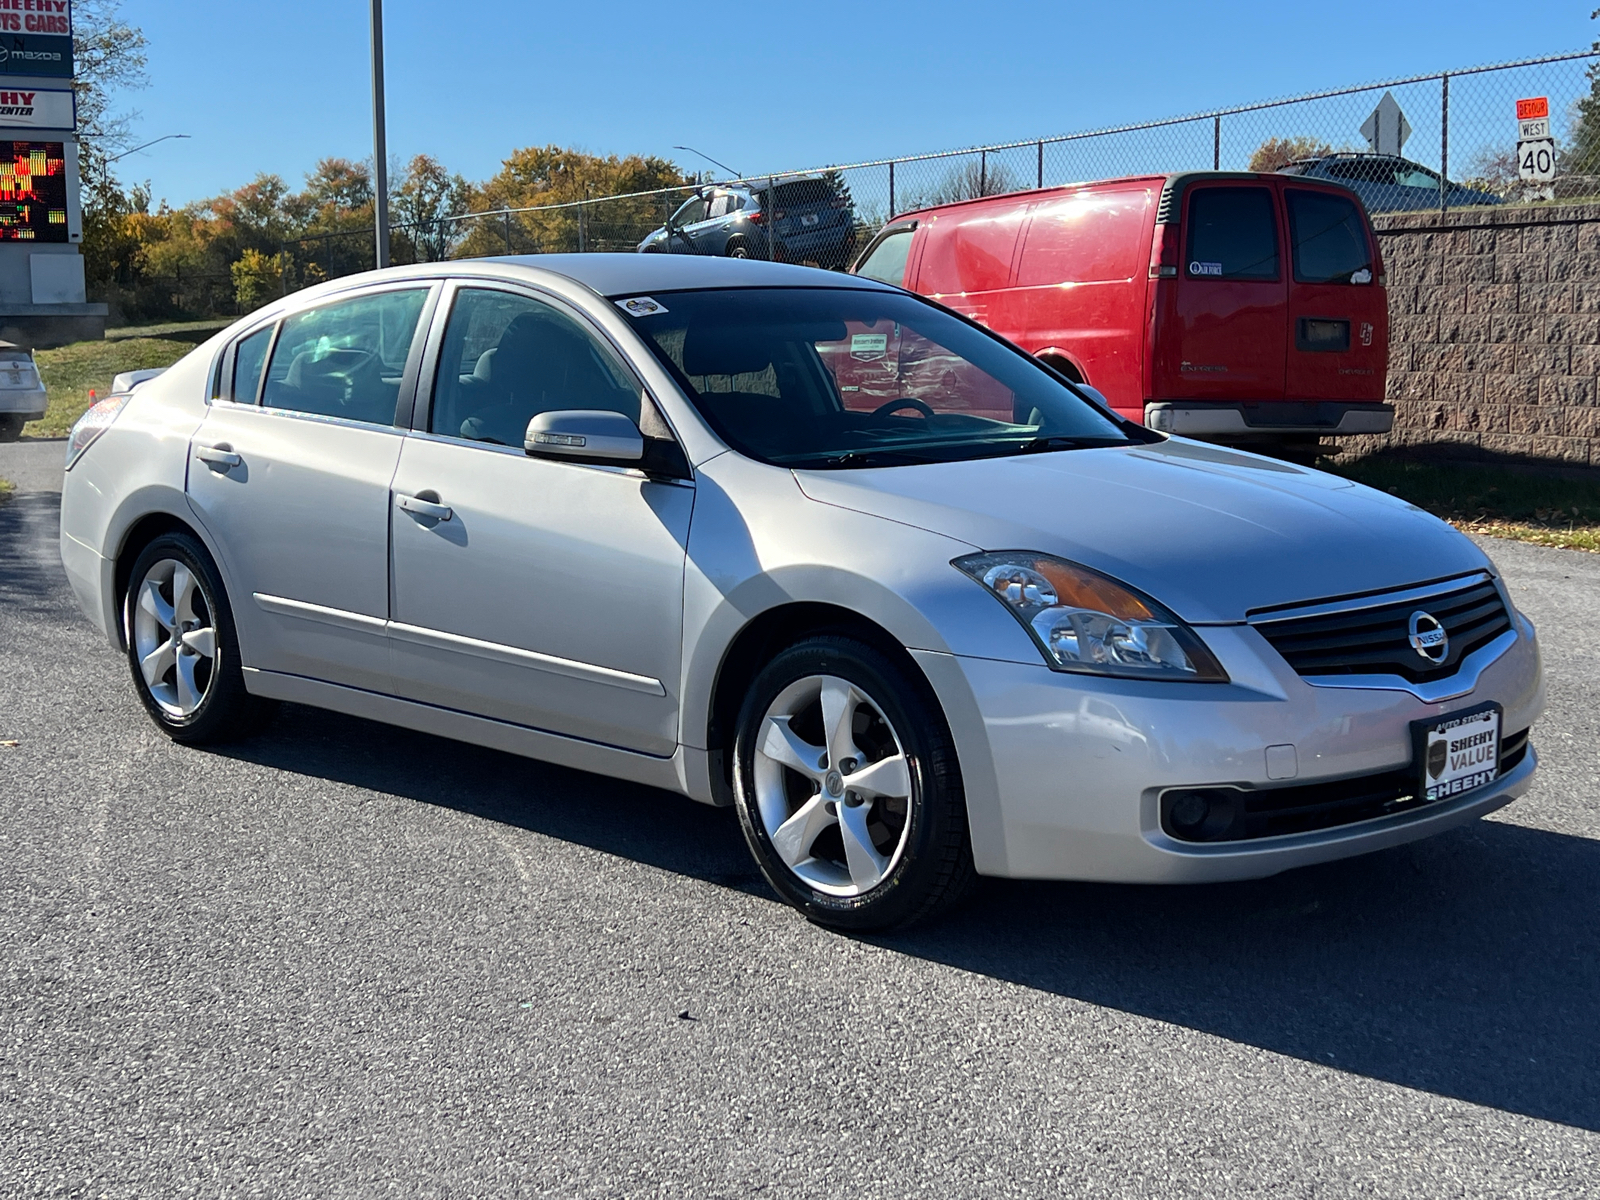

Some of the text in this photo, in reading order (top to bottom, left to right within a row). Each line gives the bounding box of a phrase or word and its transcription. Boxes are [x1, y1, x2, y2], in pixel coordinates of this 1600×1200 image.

[0, 12, 69, 34] YS CARS
[11, 51, 62, 61] mazda
[1519, 102, 1546, 117] DETOUR
[1522, 122, 1546, 137] WEST
[1522, 149, 1551, 174] 40
[1436, 719, 1460, 732] AUTO
[1450, 729, 1495, 753] SHEEHY
[1450, 744, 1494, 771] VALUE
[1427, 768, 1498, 800] SHEEHY
